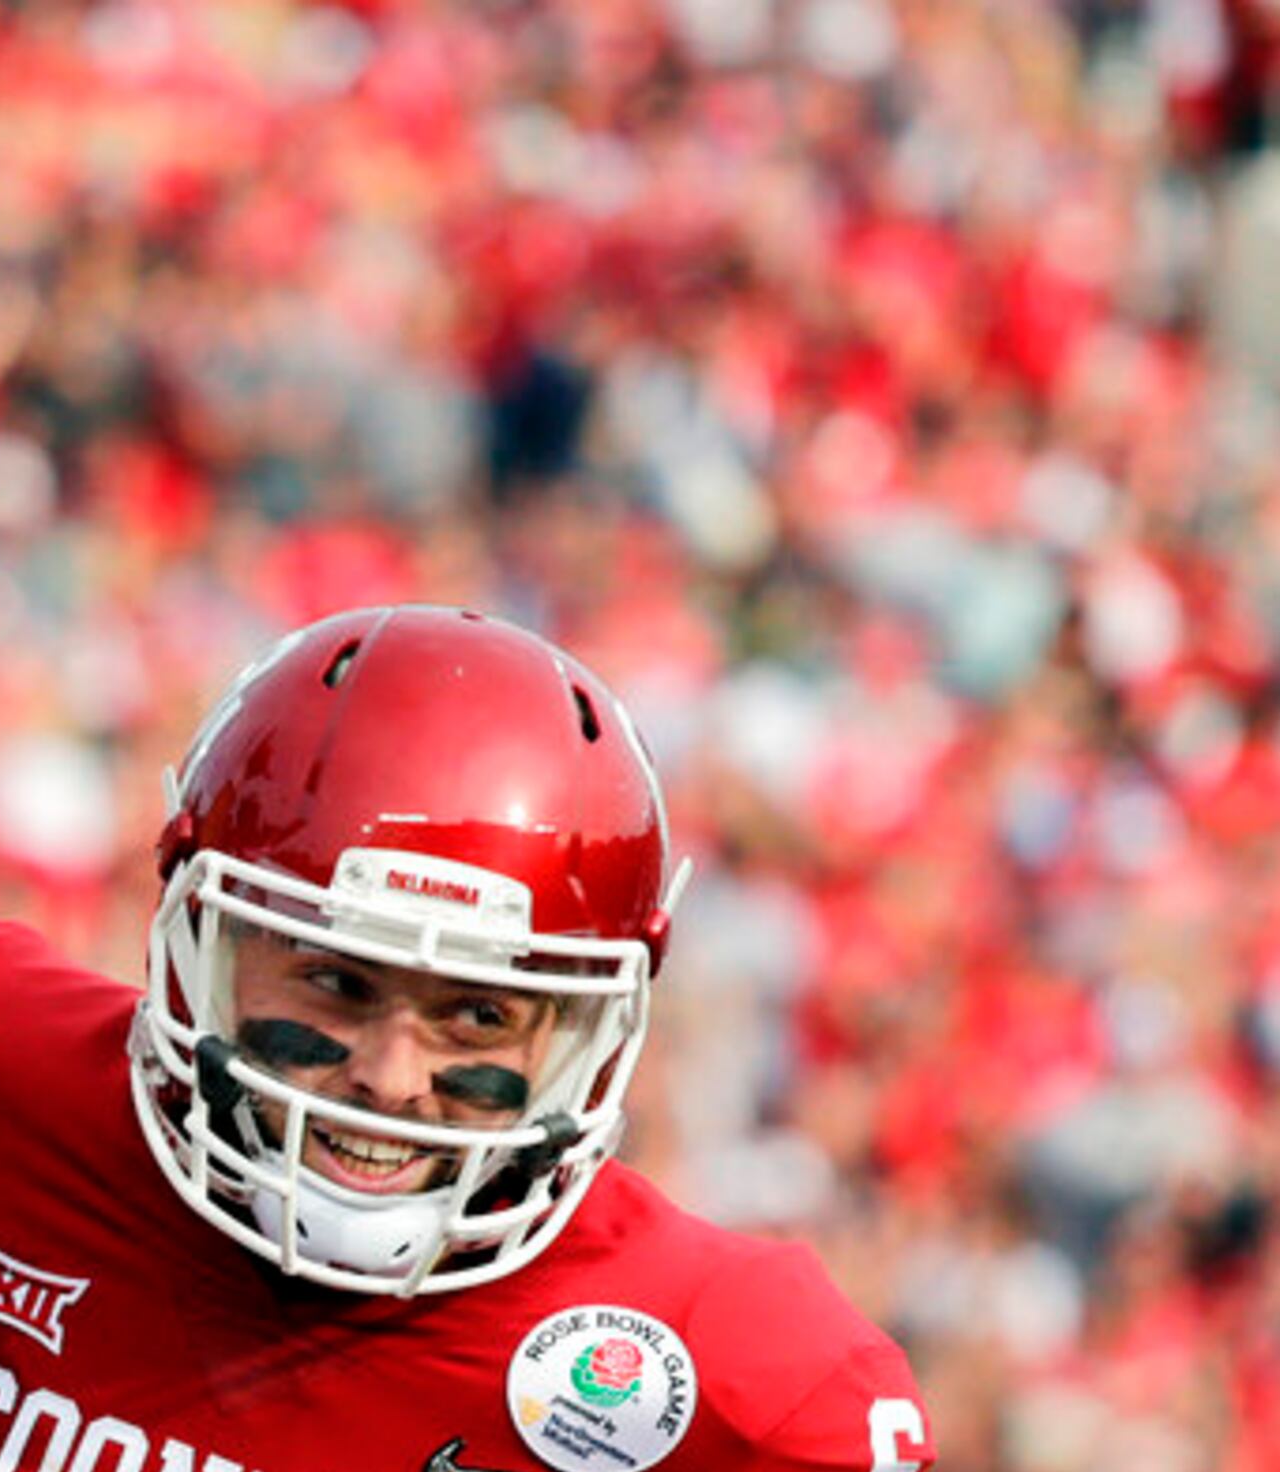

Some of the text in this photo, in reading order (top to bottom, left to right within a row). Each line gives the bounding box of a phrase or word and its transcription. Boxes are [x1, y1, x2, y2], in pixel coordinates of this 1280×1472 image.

[386, 869, 481, 906] OKLAHOMA
[524, 1312, 687, 1438] ROSE BOWL GAME
